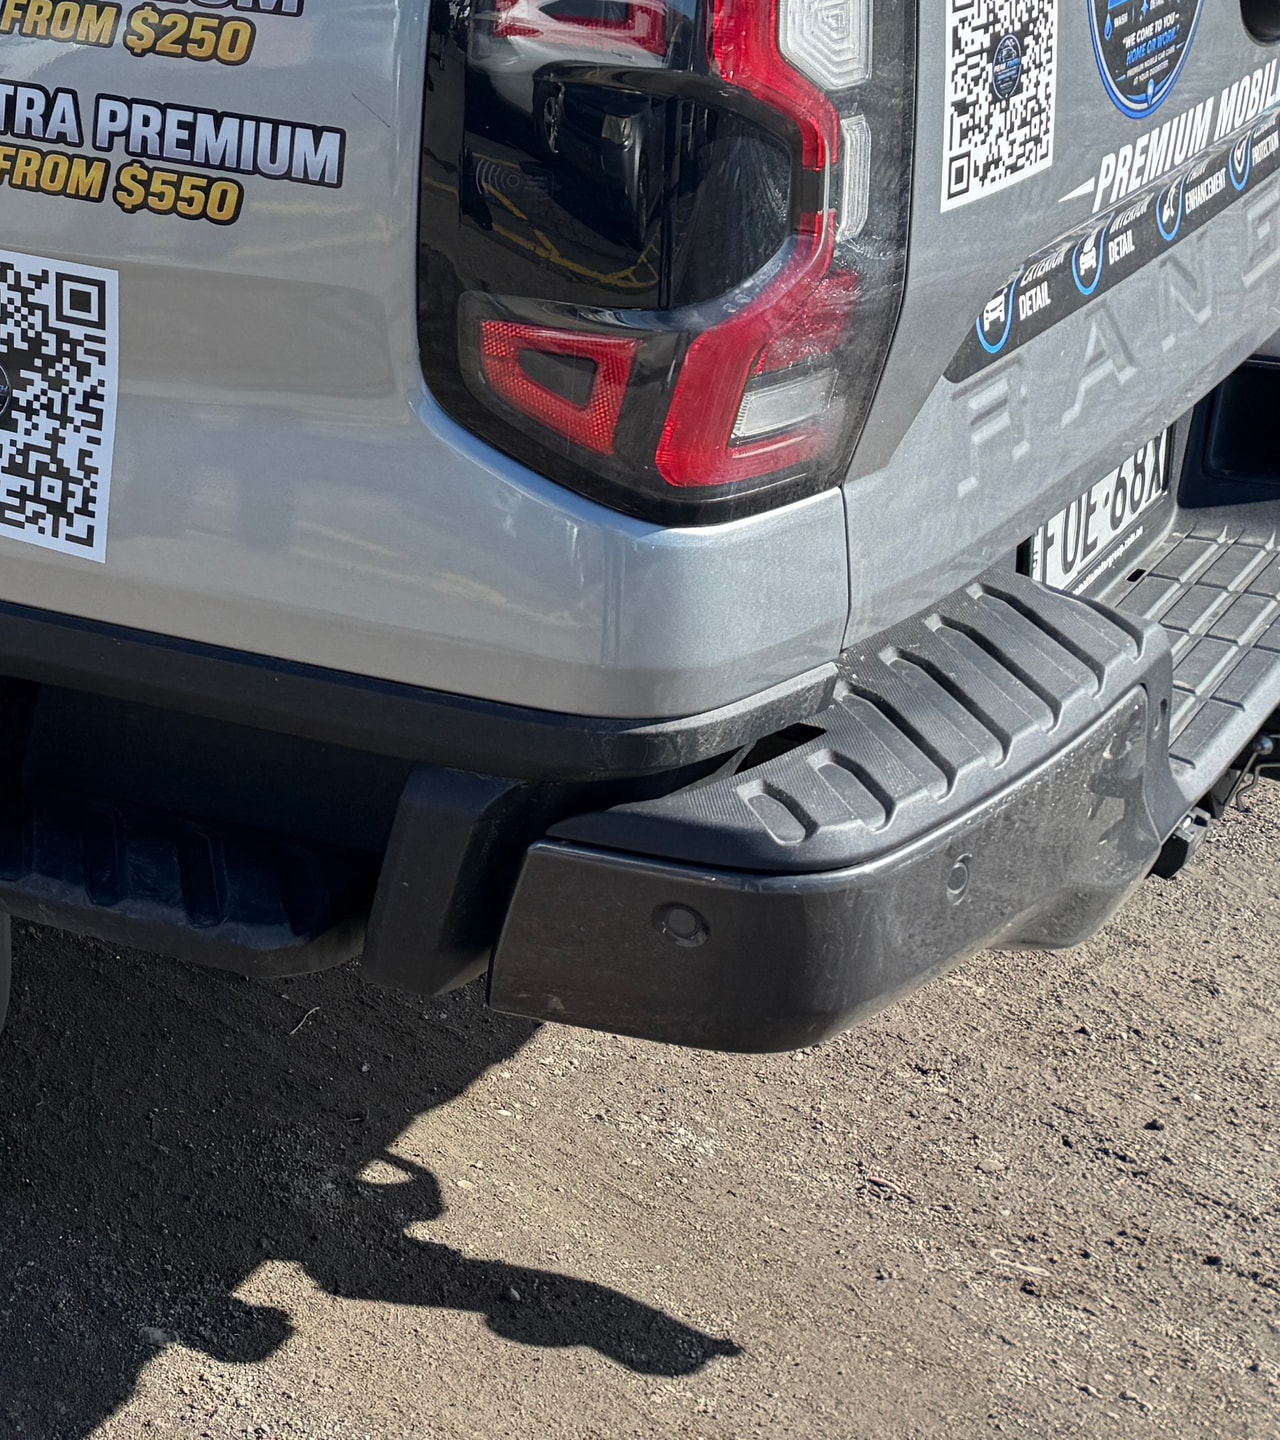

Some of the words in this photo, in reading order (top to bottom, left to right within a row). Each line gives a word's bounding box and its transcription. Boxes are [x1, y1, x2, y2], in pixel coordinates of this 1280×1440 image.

[125, 10, 254, 65] $250
[95, 94, 344, 186] PREMIUM
[1092, 96, 1214, 214] PREMIUM
[114, 162, 241, 224] $550
[1108, 229, 1135, 265] DETAIL
[1019, 281, 1051, 321] DETAIL
